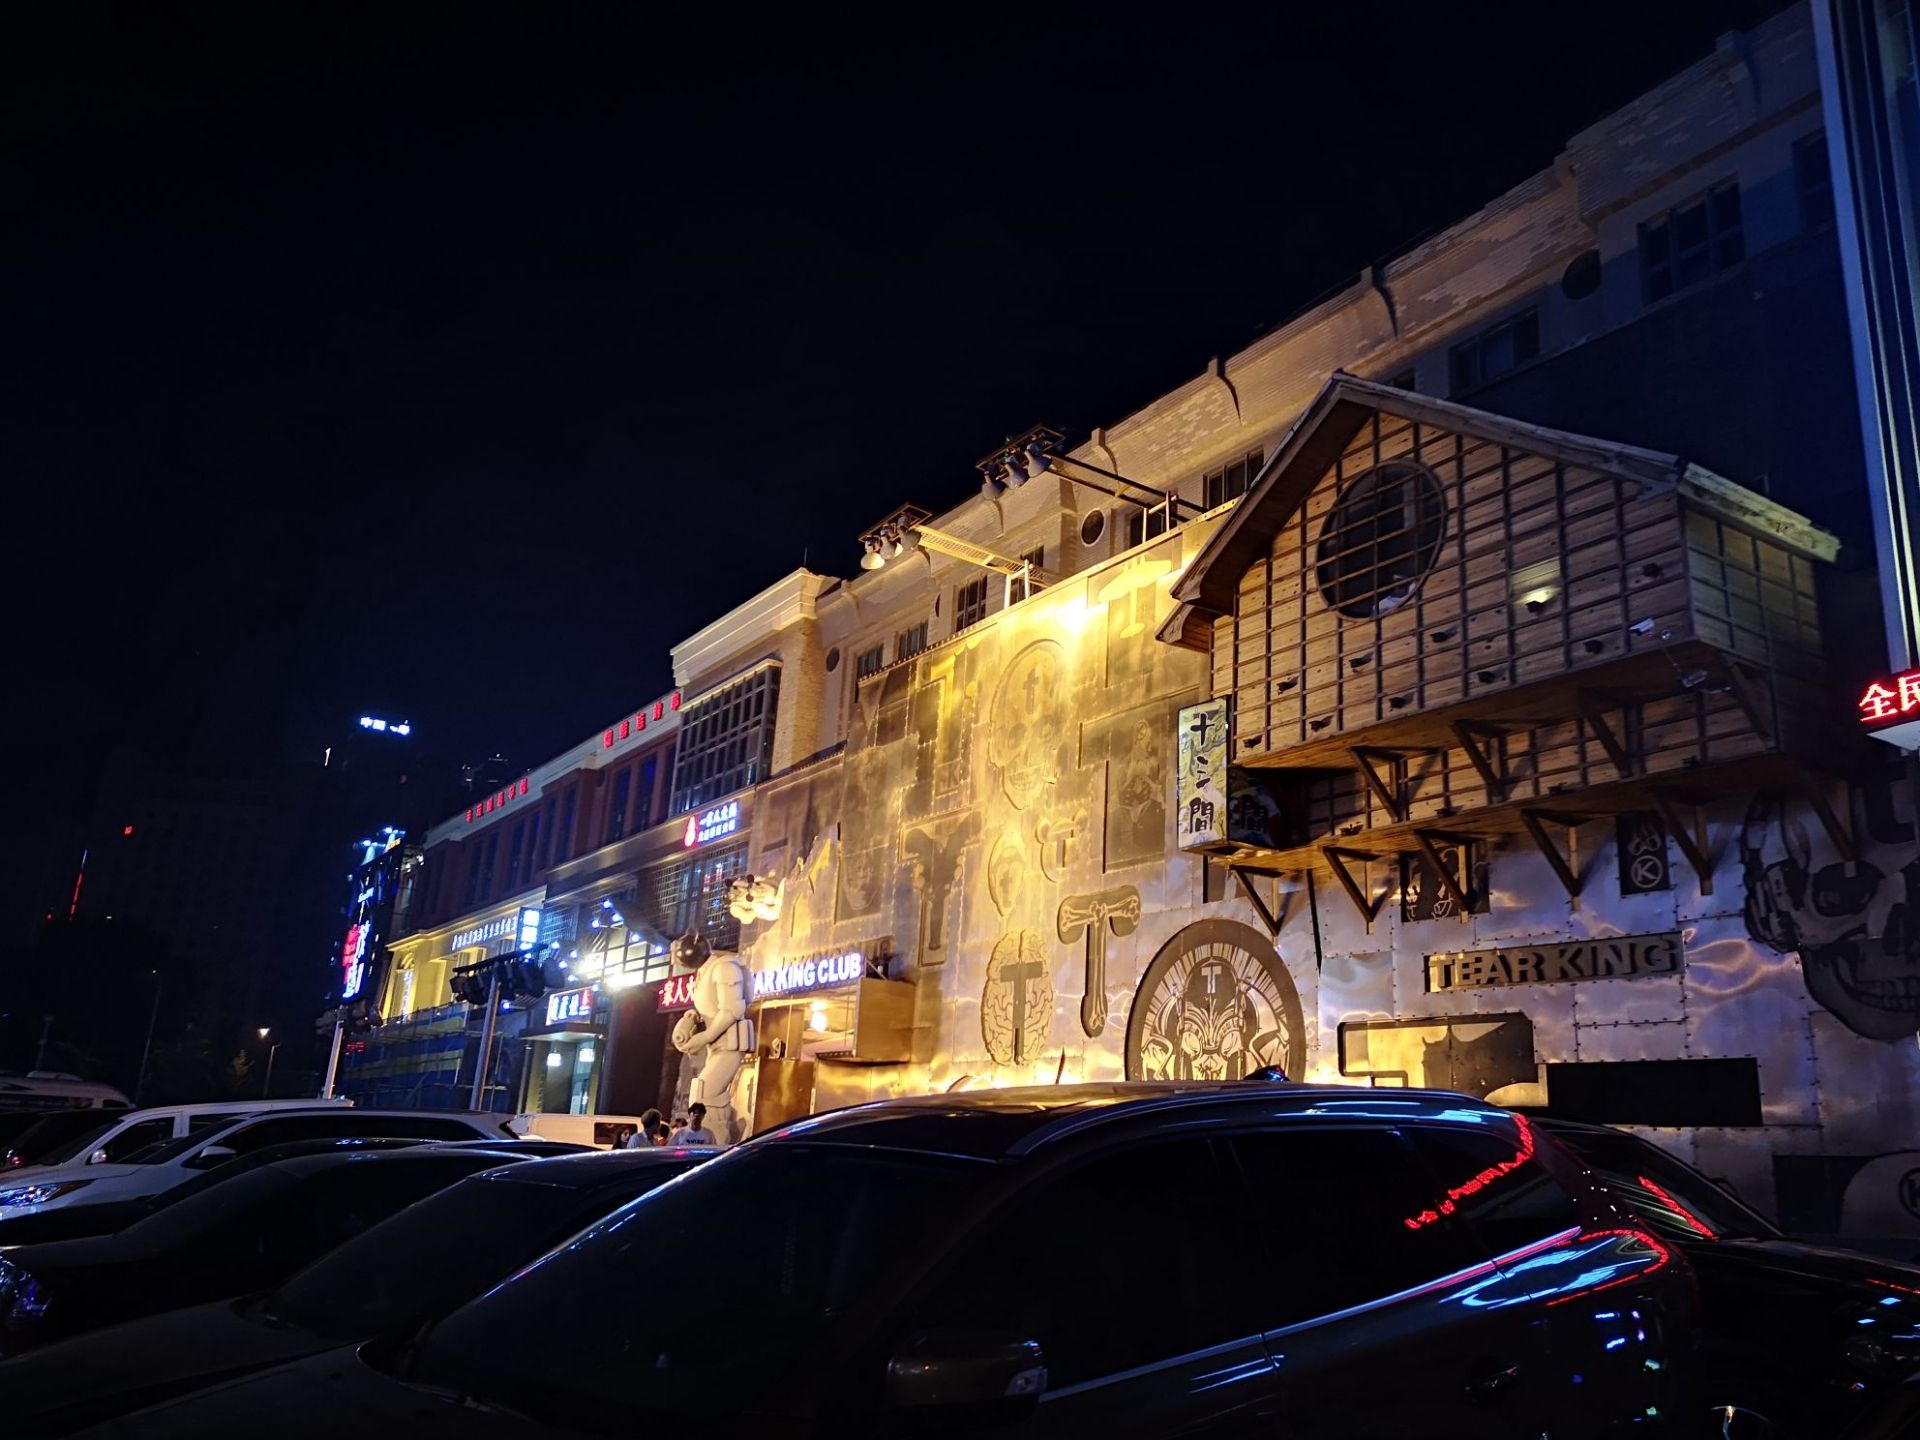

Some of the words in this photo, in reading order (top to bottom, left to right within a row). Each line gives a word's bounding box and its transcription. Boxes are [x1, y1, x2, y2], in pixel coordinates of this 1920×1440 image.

[752, 969, 777, 995] AR
[776, 961, 817, 990] KING
[817, 953, 862, 984] CLUB
[1430, 951, 1539, 993] TEAR
[1551, 942, 1677, 983] KING
